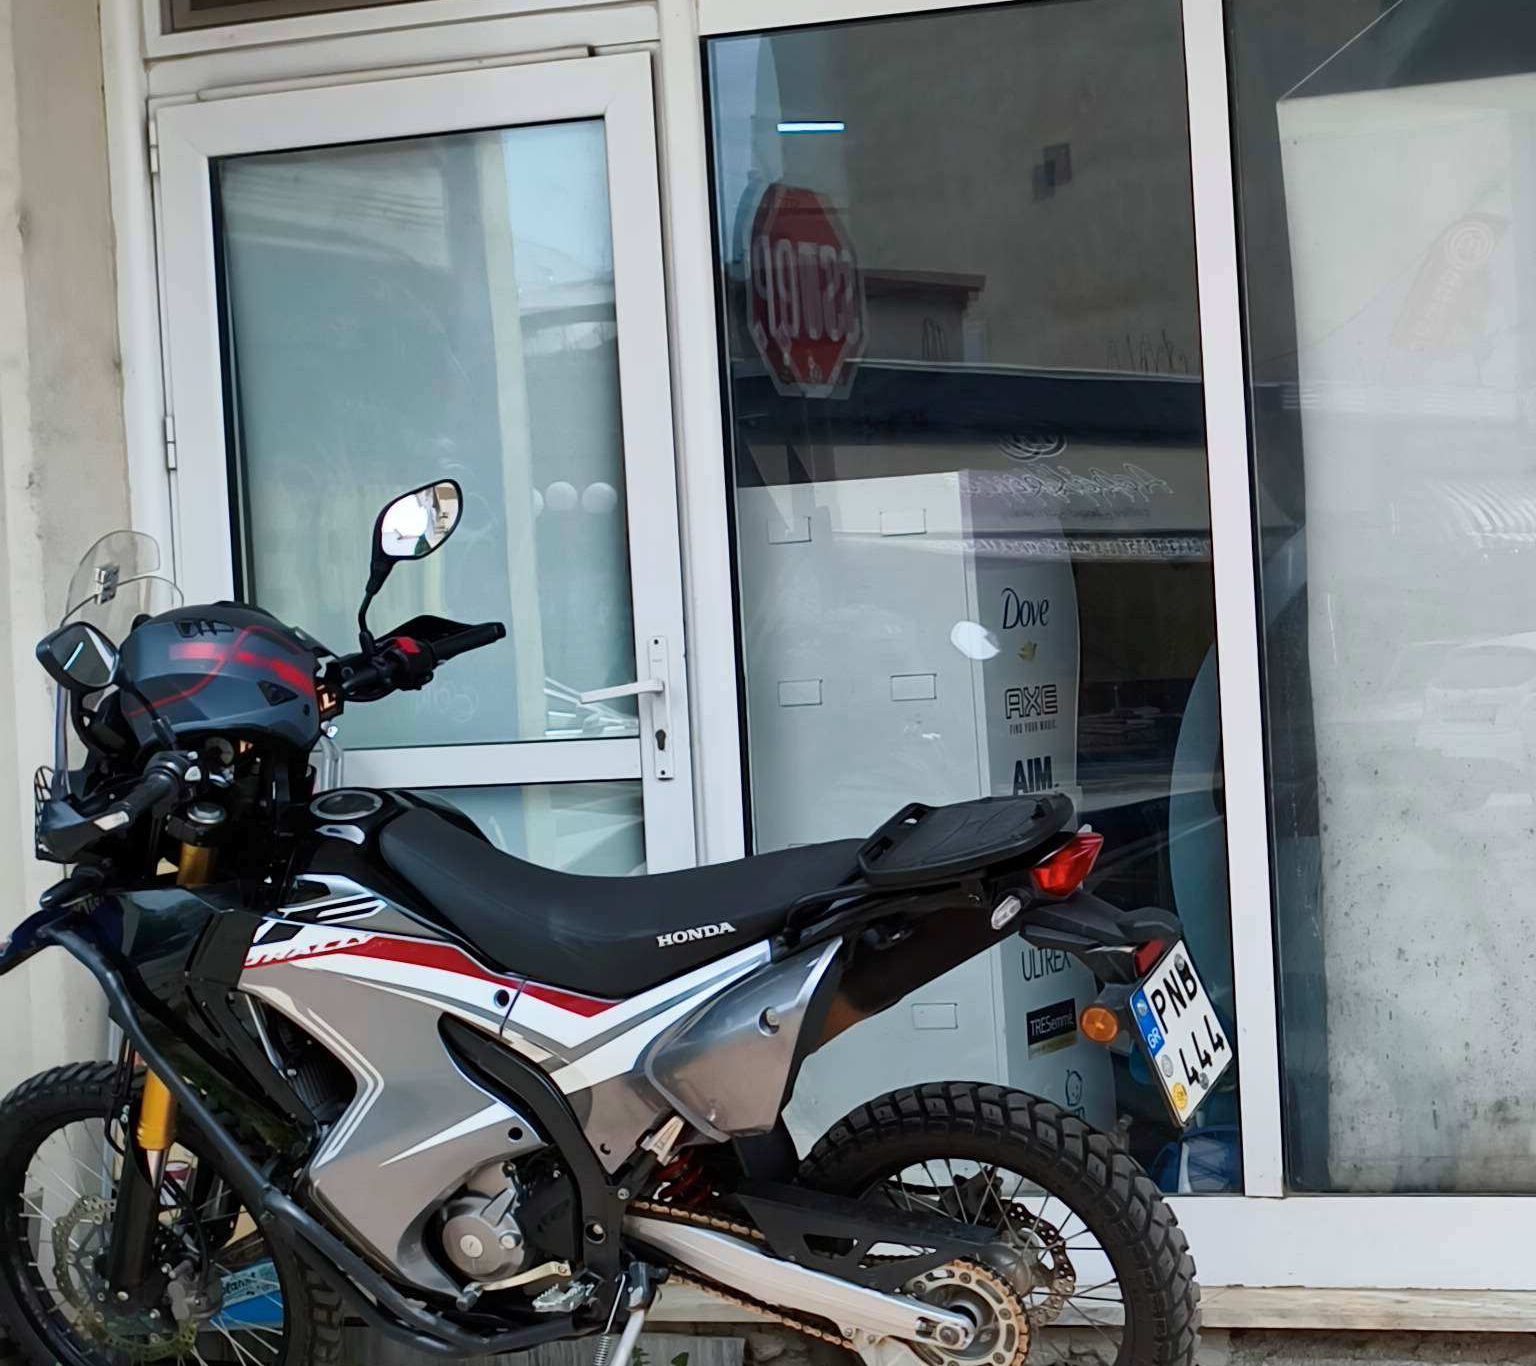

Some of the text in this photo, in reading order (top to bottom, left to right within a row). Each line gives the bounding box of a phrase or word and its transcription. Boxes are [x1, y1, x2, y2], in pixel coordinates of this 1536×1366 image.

[1001, 587, 1050, 629] Dove
[1004, 684, 1058, 720] AXE
[655, 921, 737, 948] HONDA
[1150, 960, 1198, 1035] PNB
[1146, 1026, 1163, 1050] GR
[1178, 1014, 1225, 1086] 444
